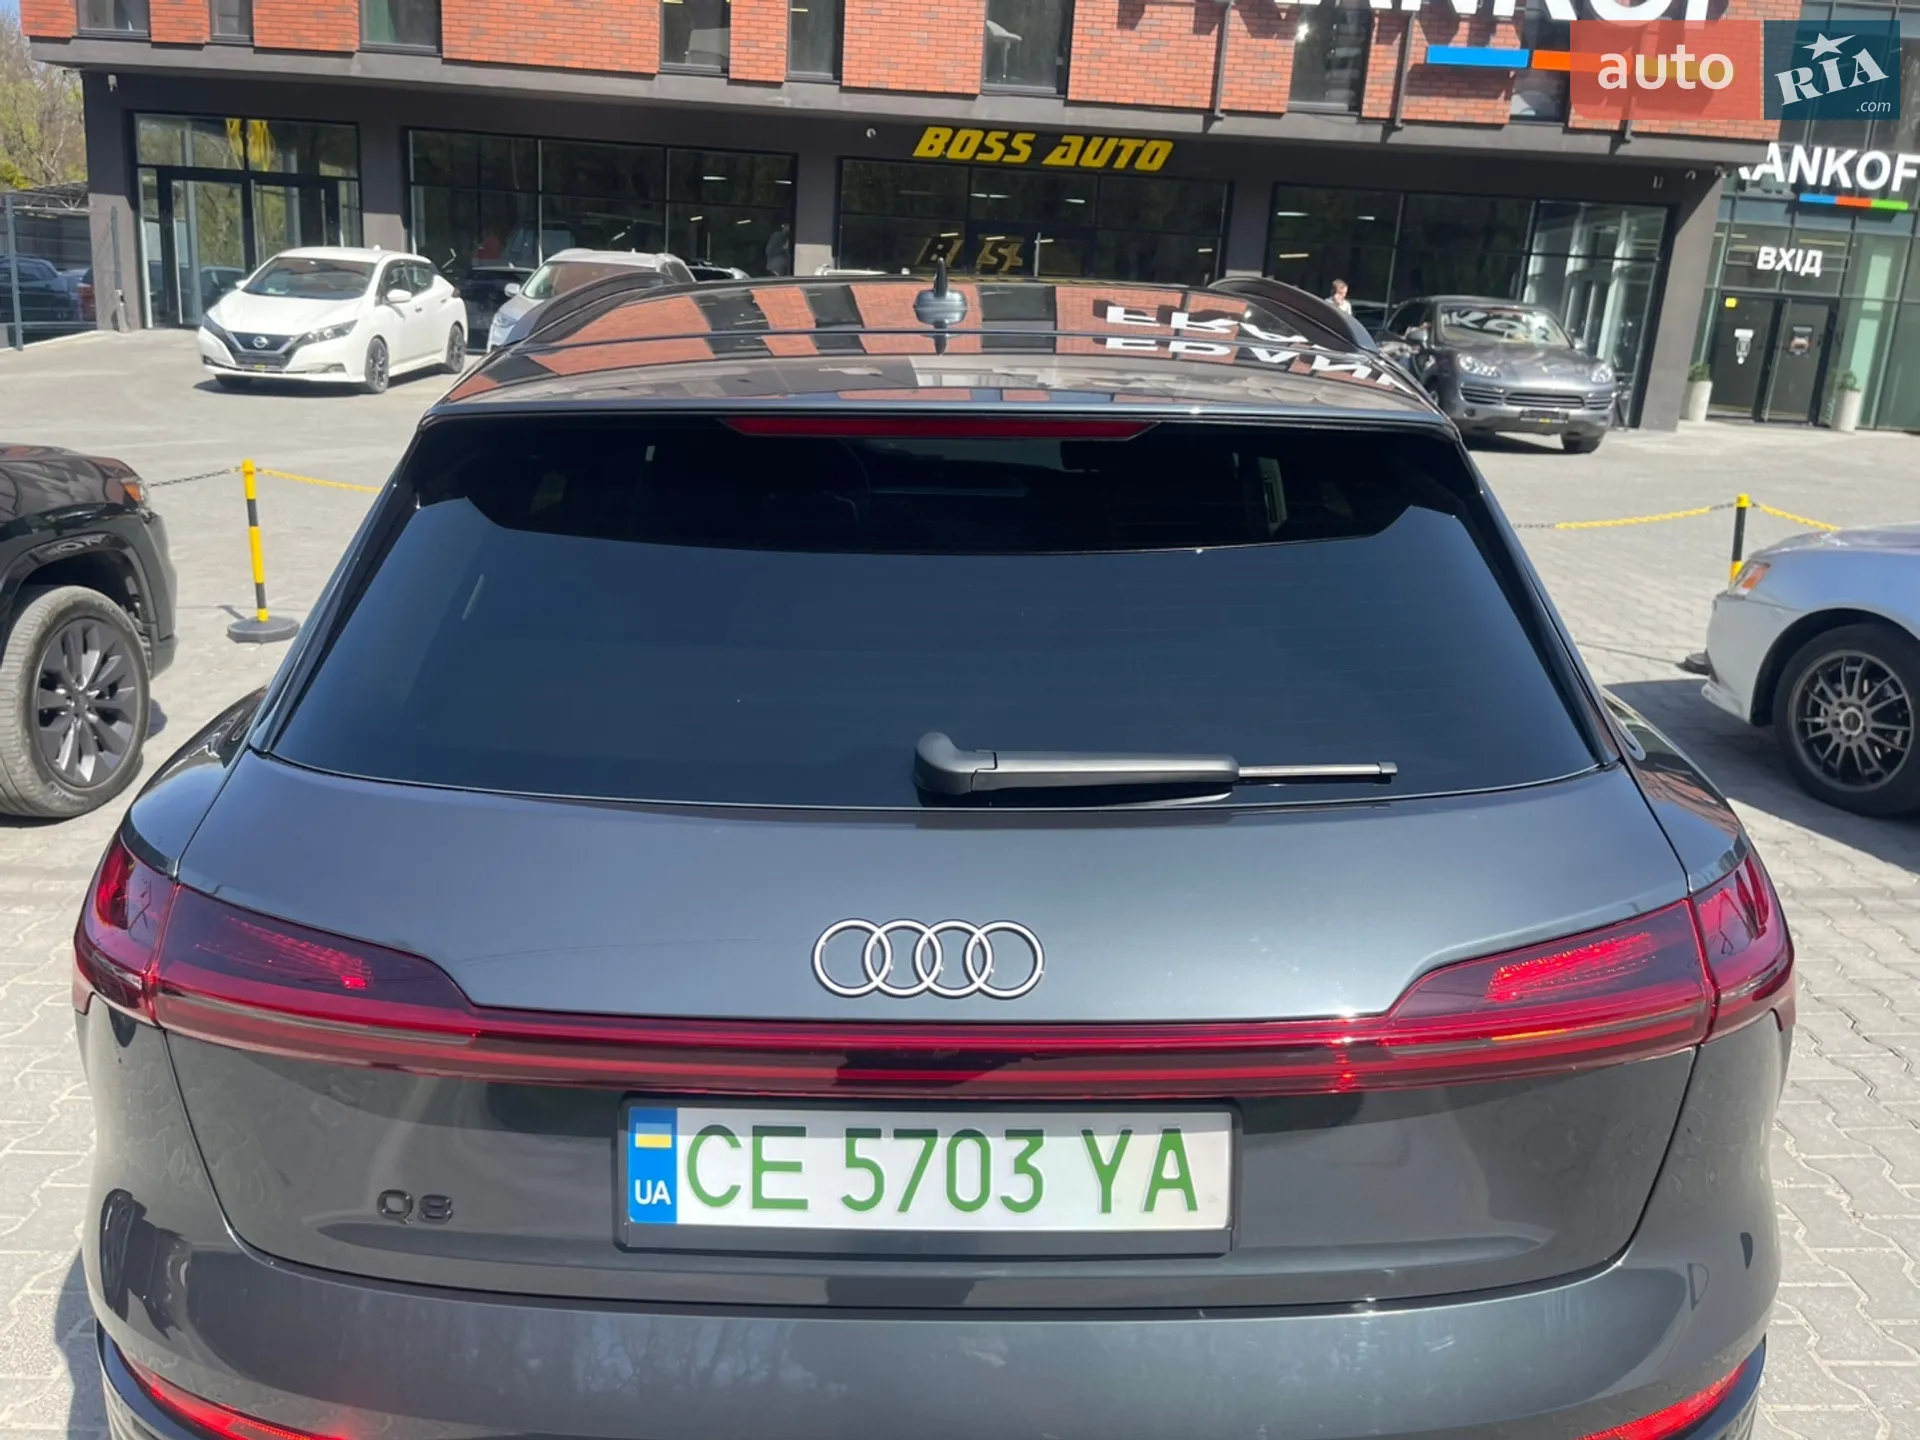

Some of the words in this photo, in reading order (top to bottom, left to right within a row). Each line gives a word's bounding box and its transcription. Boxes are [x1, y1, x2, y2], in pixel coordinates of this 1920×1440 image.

[912, 126, 1036, 164] BOSS
[1041, 134, 1174, 172] AUTO
[1756, 246, 1823, 278] ВХІД
[686, 1124, 809, 1210] CE
[840, 1128, 1045, 1213] 5703
[1080, 1128, 1198, 1214] YA
[377, 1189, 453, 1224] Q8
[634, 1179, 671, 1205] UA
